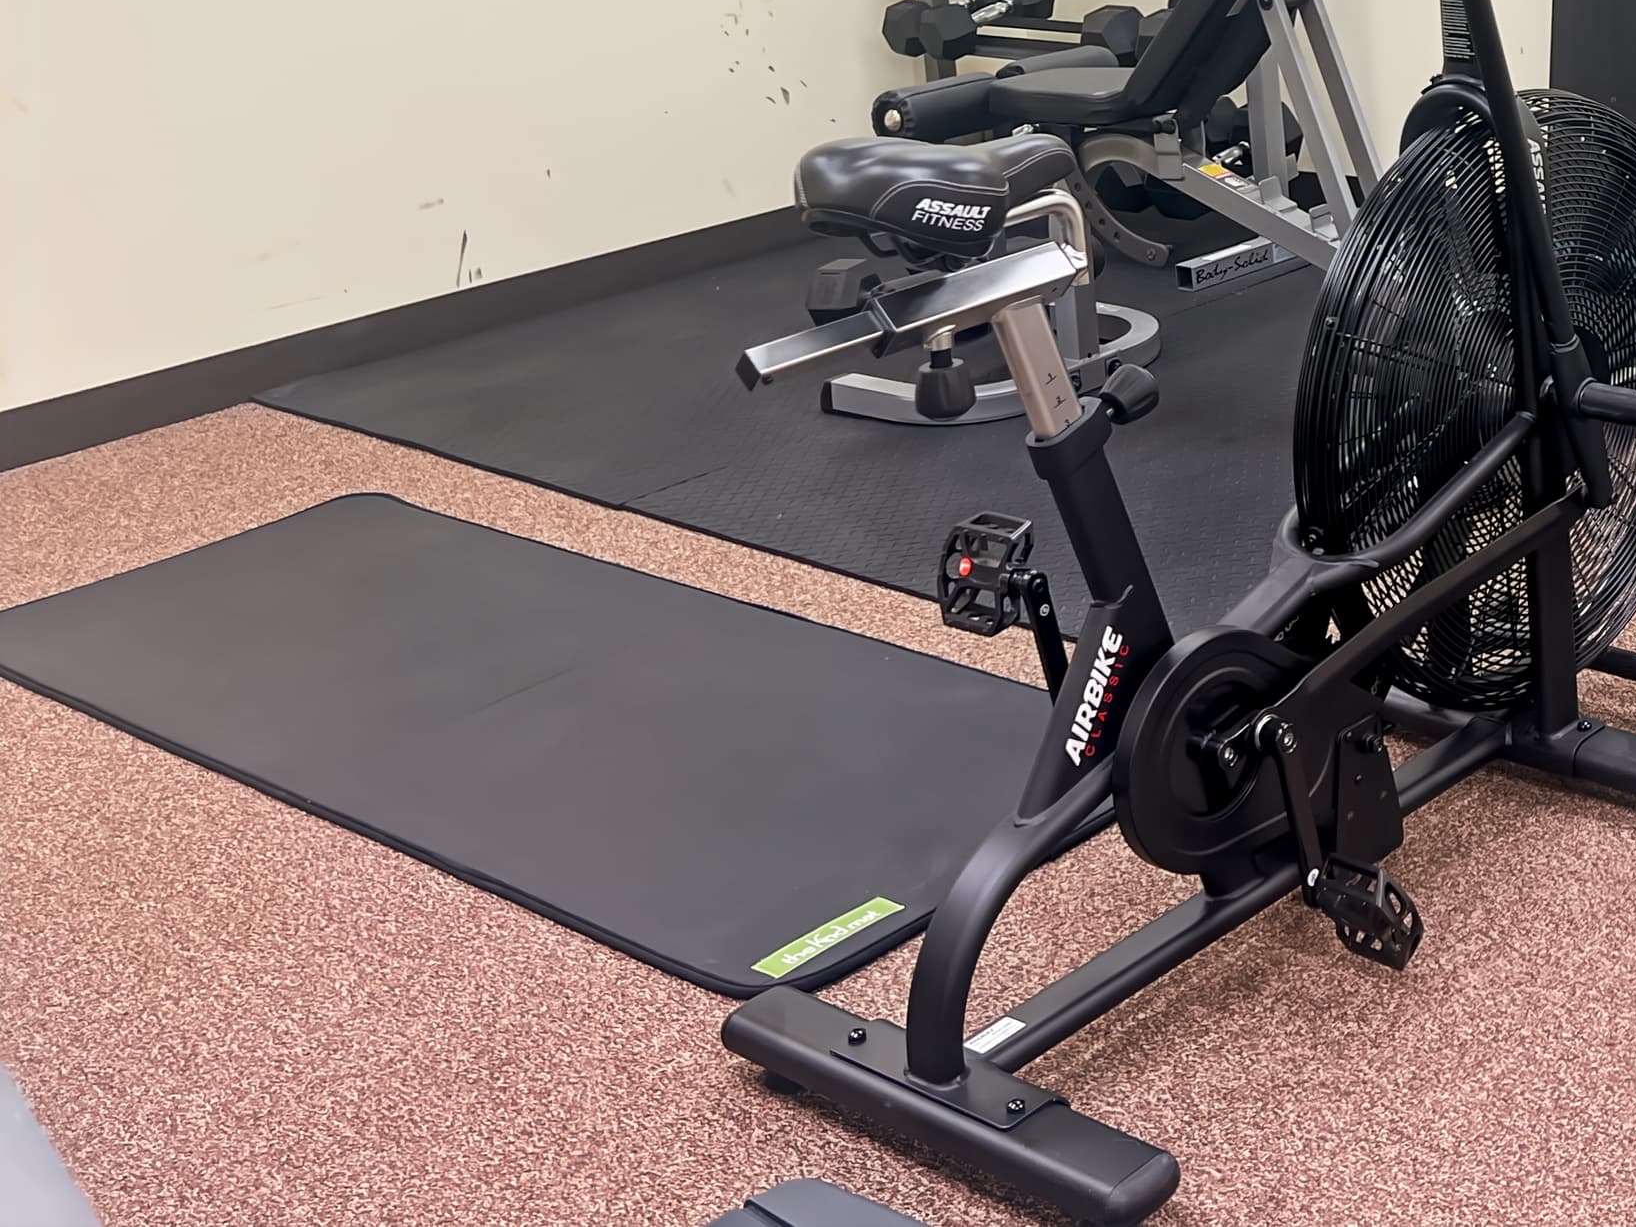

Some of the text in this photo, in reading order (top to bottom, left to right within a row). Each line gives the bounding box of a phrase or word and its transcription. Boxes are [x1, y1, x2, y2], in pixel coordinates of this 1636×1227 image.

[911, 210, 984, 231] FITNESS
[916, 198, 991, 219] ASSAULT
[1195, 249, 1269, 284] Body-Solid
[1065, 625, 1123, 766] AIRBIKE
[1085, 645, 1129, 756] CLASSIC
